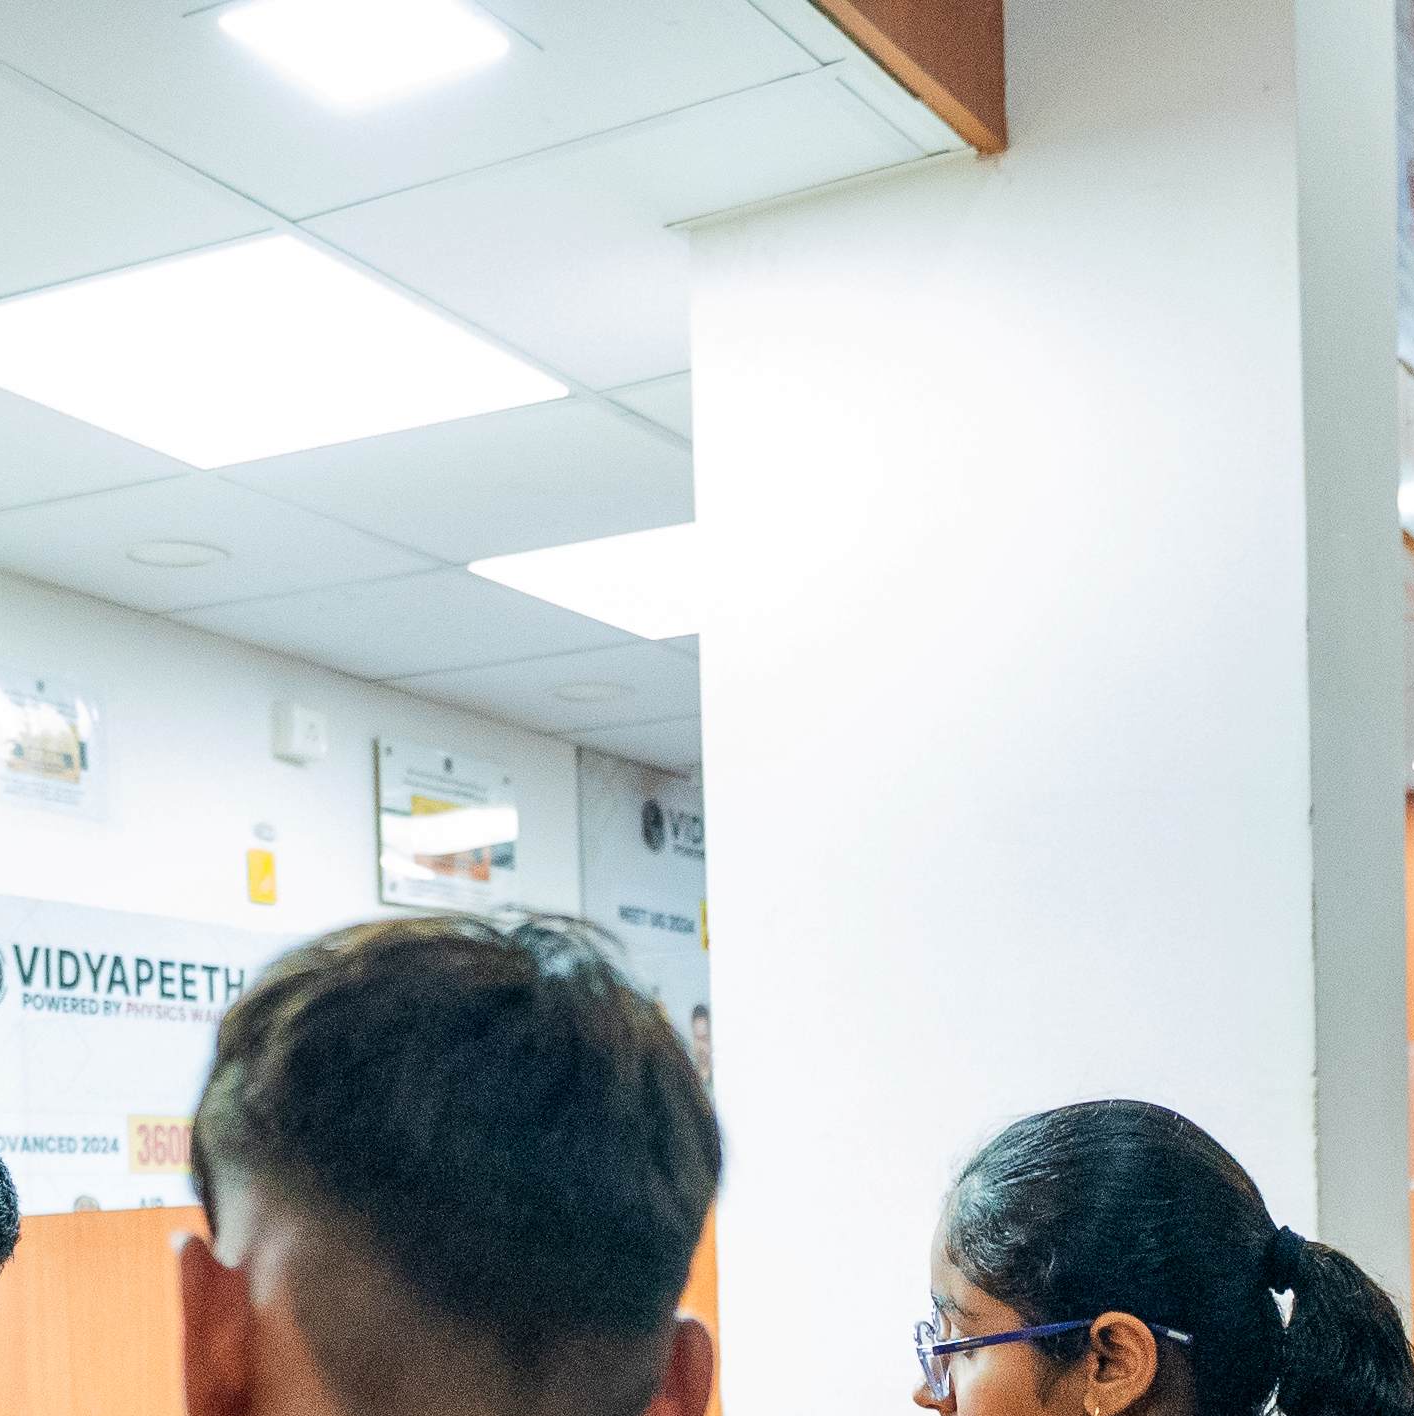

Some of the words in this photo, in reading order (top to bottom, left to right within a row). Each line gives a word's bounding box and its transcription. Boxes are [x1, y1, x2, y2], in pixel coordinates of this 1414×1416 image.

[14, 944, 245, 1003] VIDYAPEETH
[23, 992, 99, 1016] POWERED
[103, 1000, 121, 1017] BY
[125, 1002, 187, 1021] PHYSICS
[81, 1137, 119, 1154] 2024
